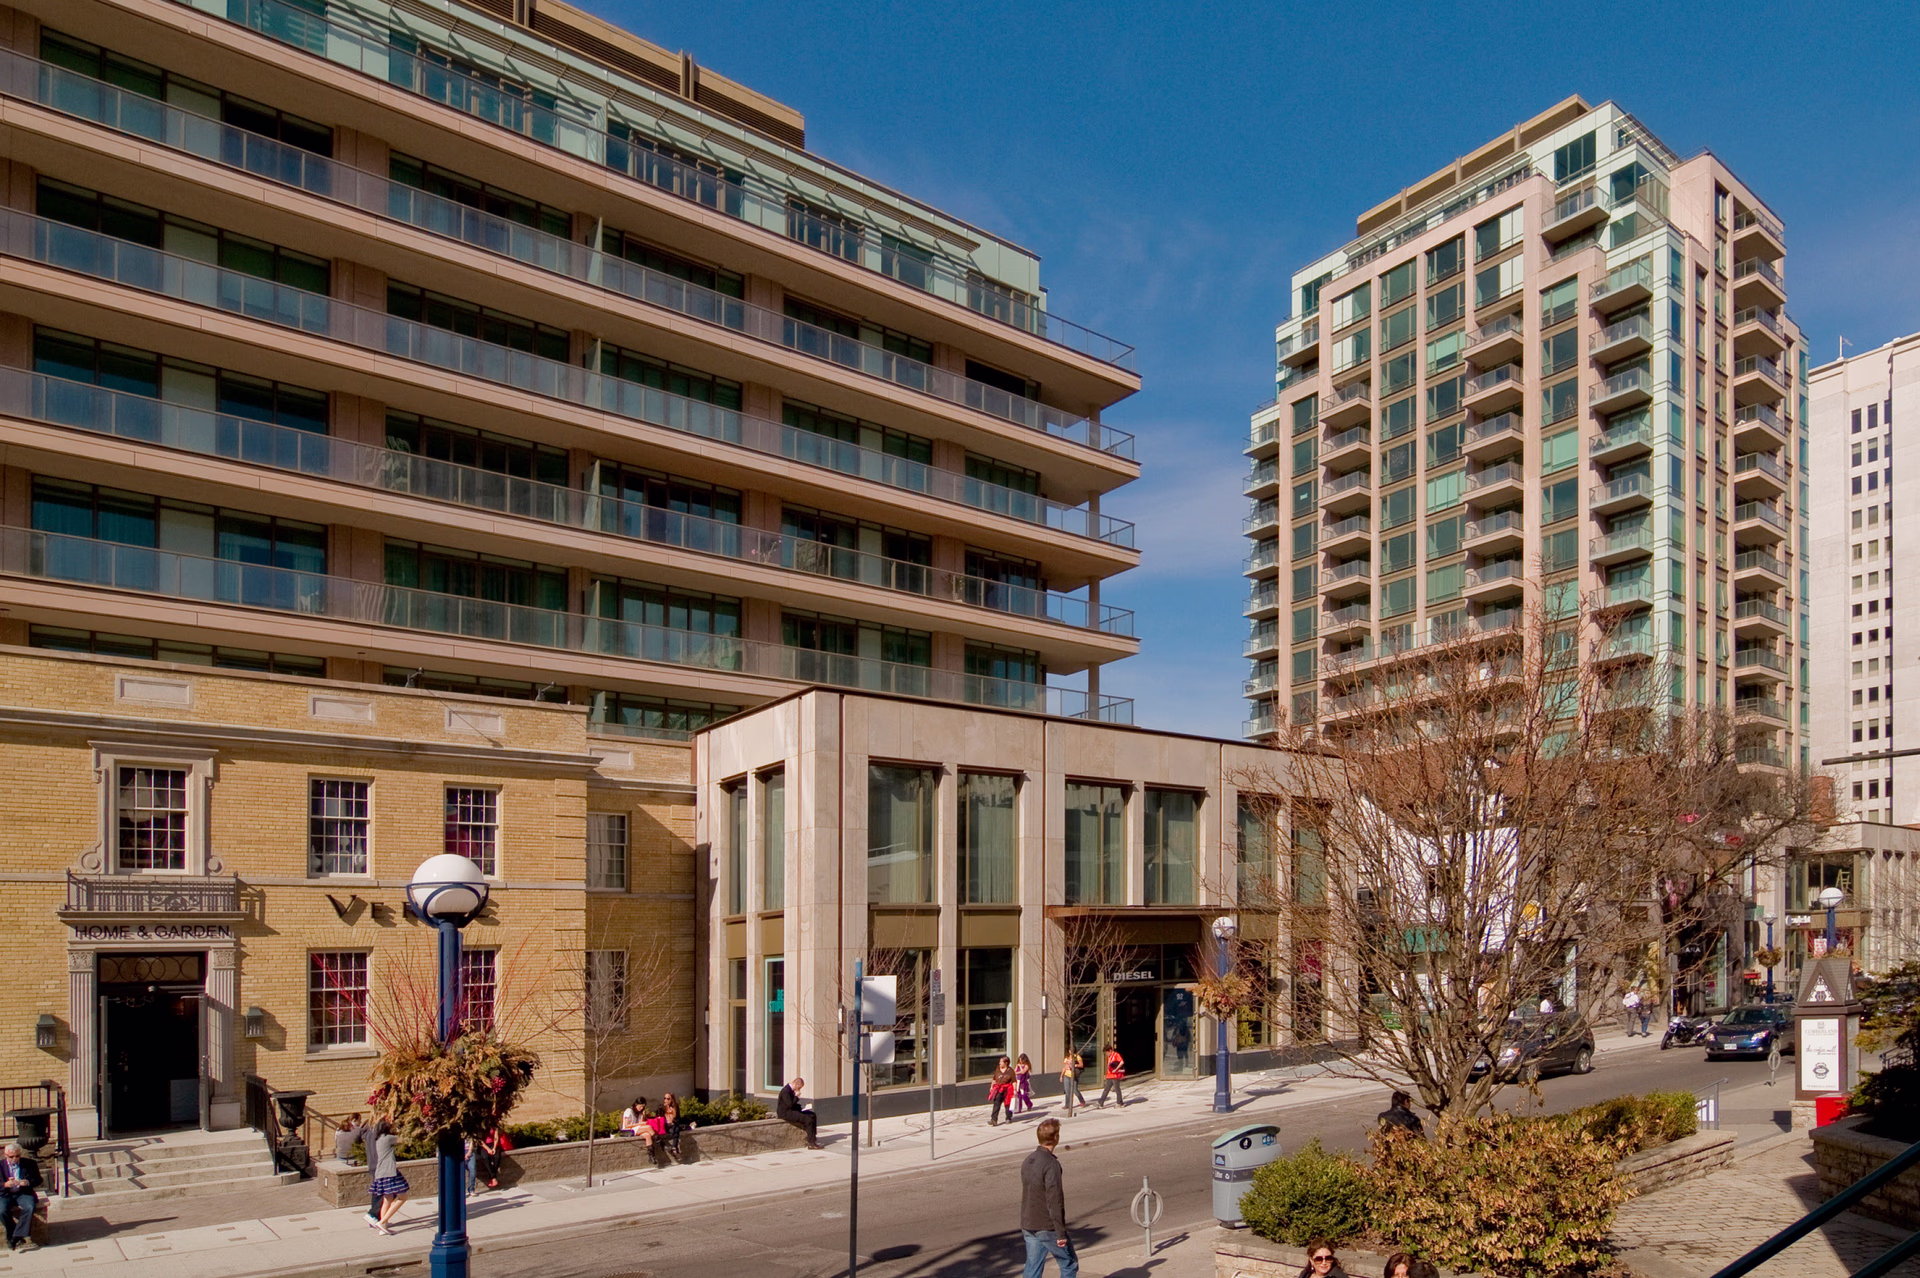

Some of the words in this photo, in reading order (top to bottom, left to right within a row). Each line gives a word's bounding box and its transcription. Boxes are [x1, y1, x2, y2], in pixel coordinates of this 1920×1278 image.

[75, 925, 130, 938] HOME
[136, 925, 148, 938] &
[154, 925, 230, 938] GARDEN
[1113, 970, 1155, 981] DIESEL
